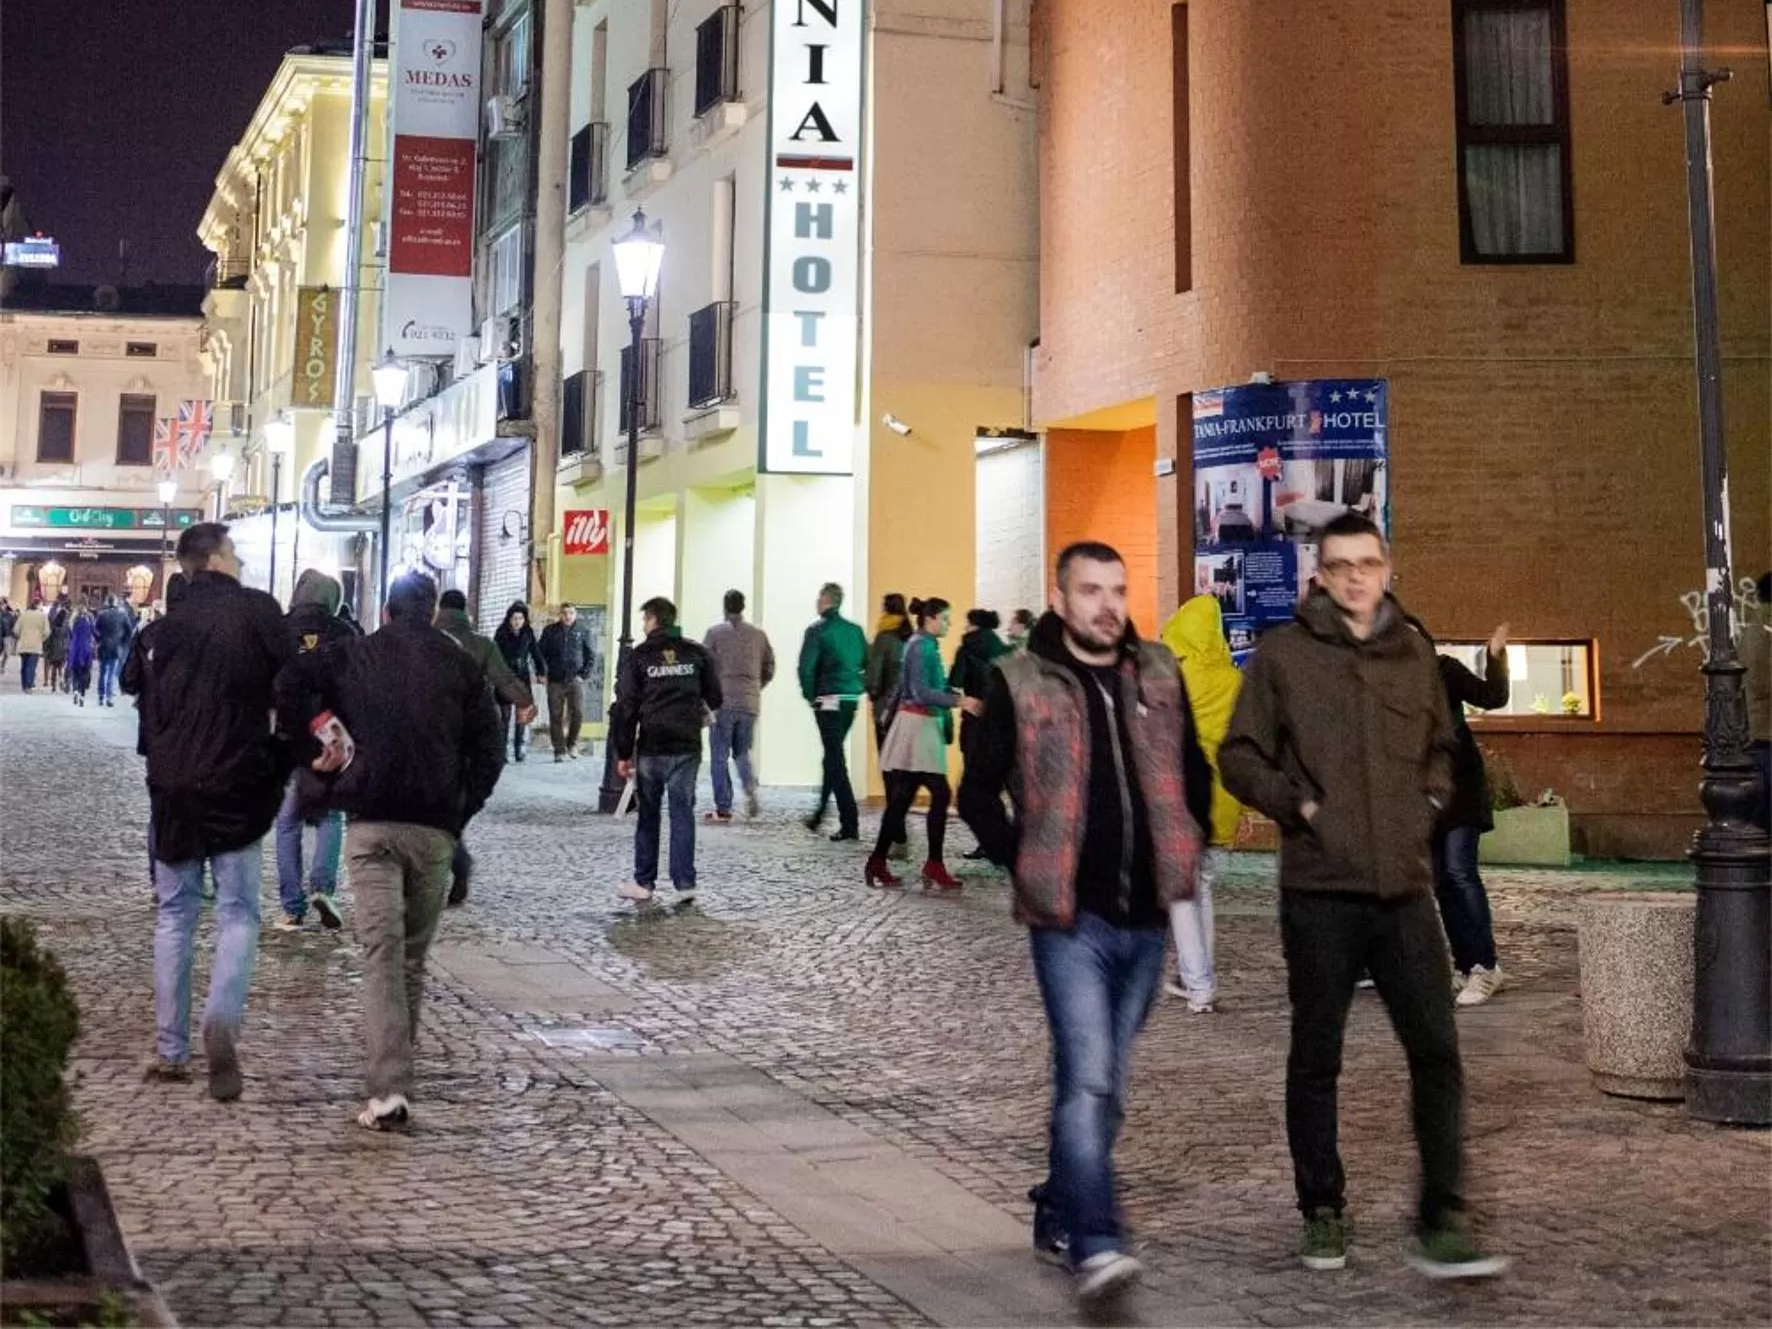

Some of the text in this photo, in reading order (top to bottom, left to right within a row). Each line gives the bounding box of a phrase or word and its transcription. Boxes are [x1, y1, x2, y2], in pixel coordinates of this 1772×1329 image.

[405, 70, 473, 88] MEDAS
[791, 202, 834, 458] HOTEL
[306, 292, 327, 402] GYROS
[1194, 412, 1387, 439] TANIA-FRANKFURT HOTEL
[69, 508, 90, 523] Old
[566, 509, 606, 552] illy
[647, 663, 694, 678] GUINNESS
